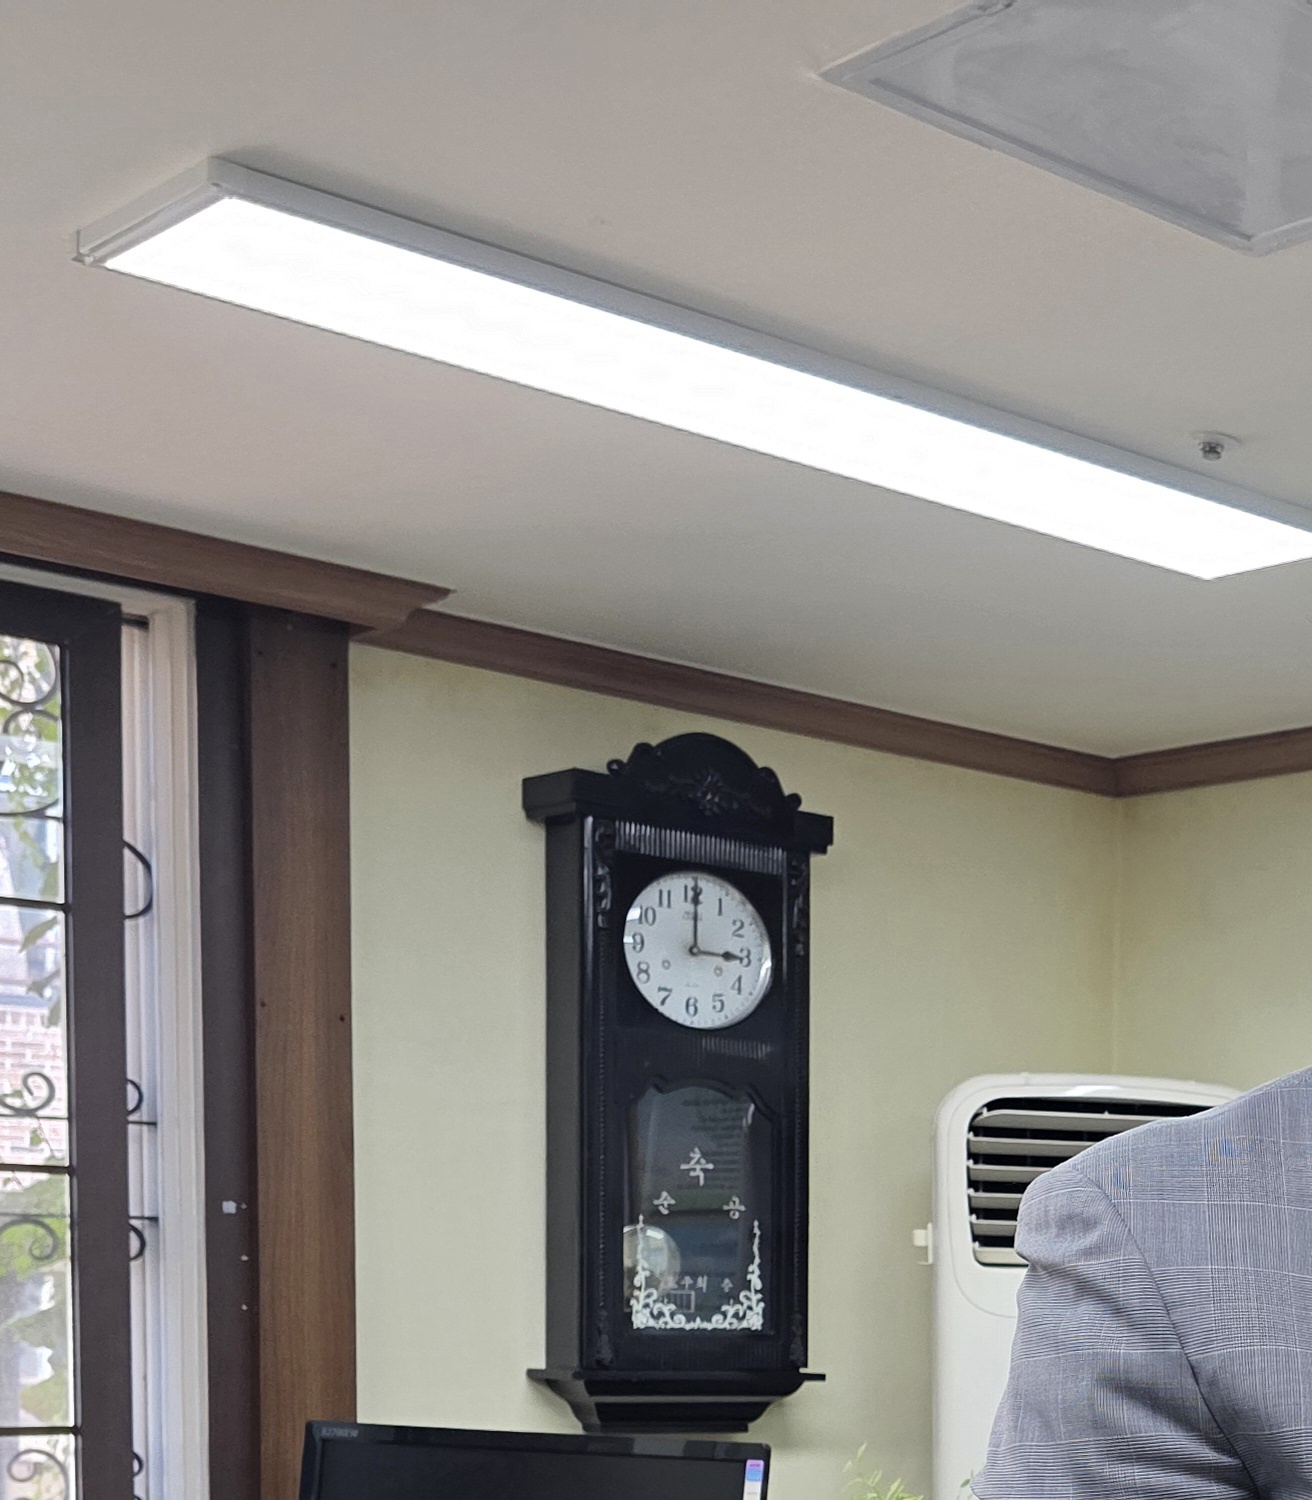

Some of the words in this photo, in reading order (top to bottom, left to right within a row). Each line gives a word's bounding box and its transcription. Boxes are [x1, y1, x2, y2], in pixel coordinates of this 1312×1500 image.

[658, 888, 671, 908] 11
[717, 898, 723, 916] 1
[638, 905, 657, 926] 10
[732, 919, 745, 938] 2
[632, 932, 644, 953] 9
[739, 947, 752, 968] 3
[637, 961, 650, 984] 8
[731, 975, 742, 995] 4
[657, 986, 672, 1007] 7
[685, 996, 698, 1017] 6
[712, 993, 725, 1013] 5
